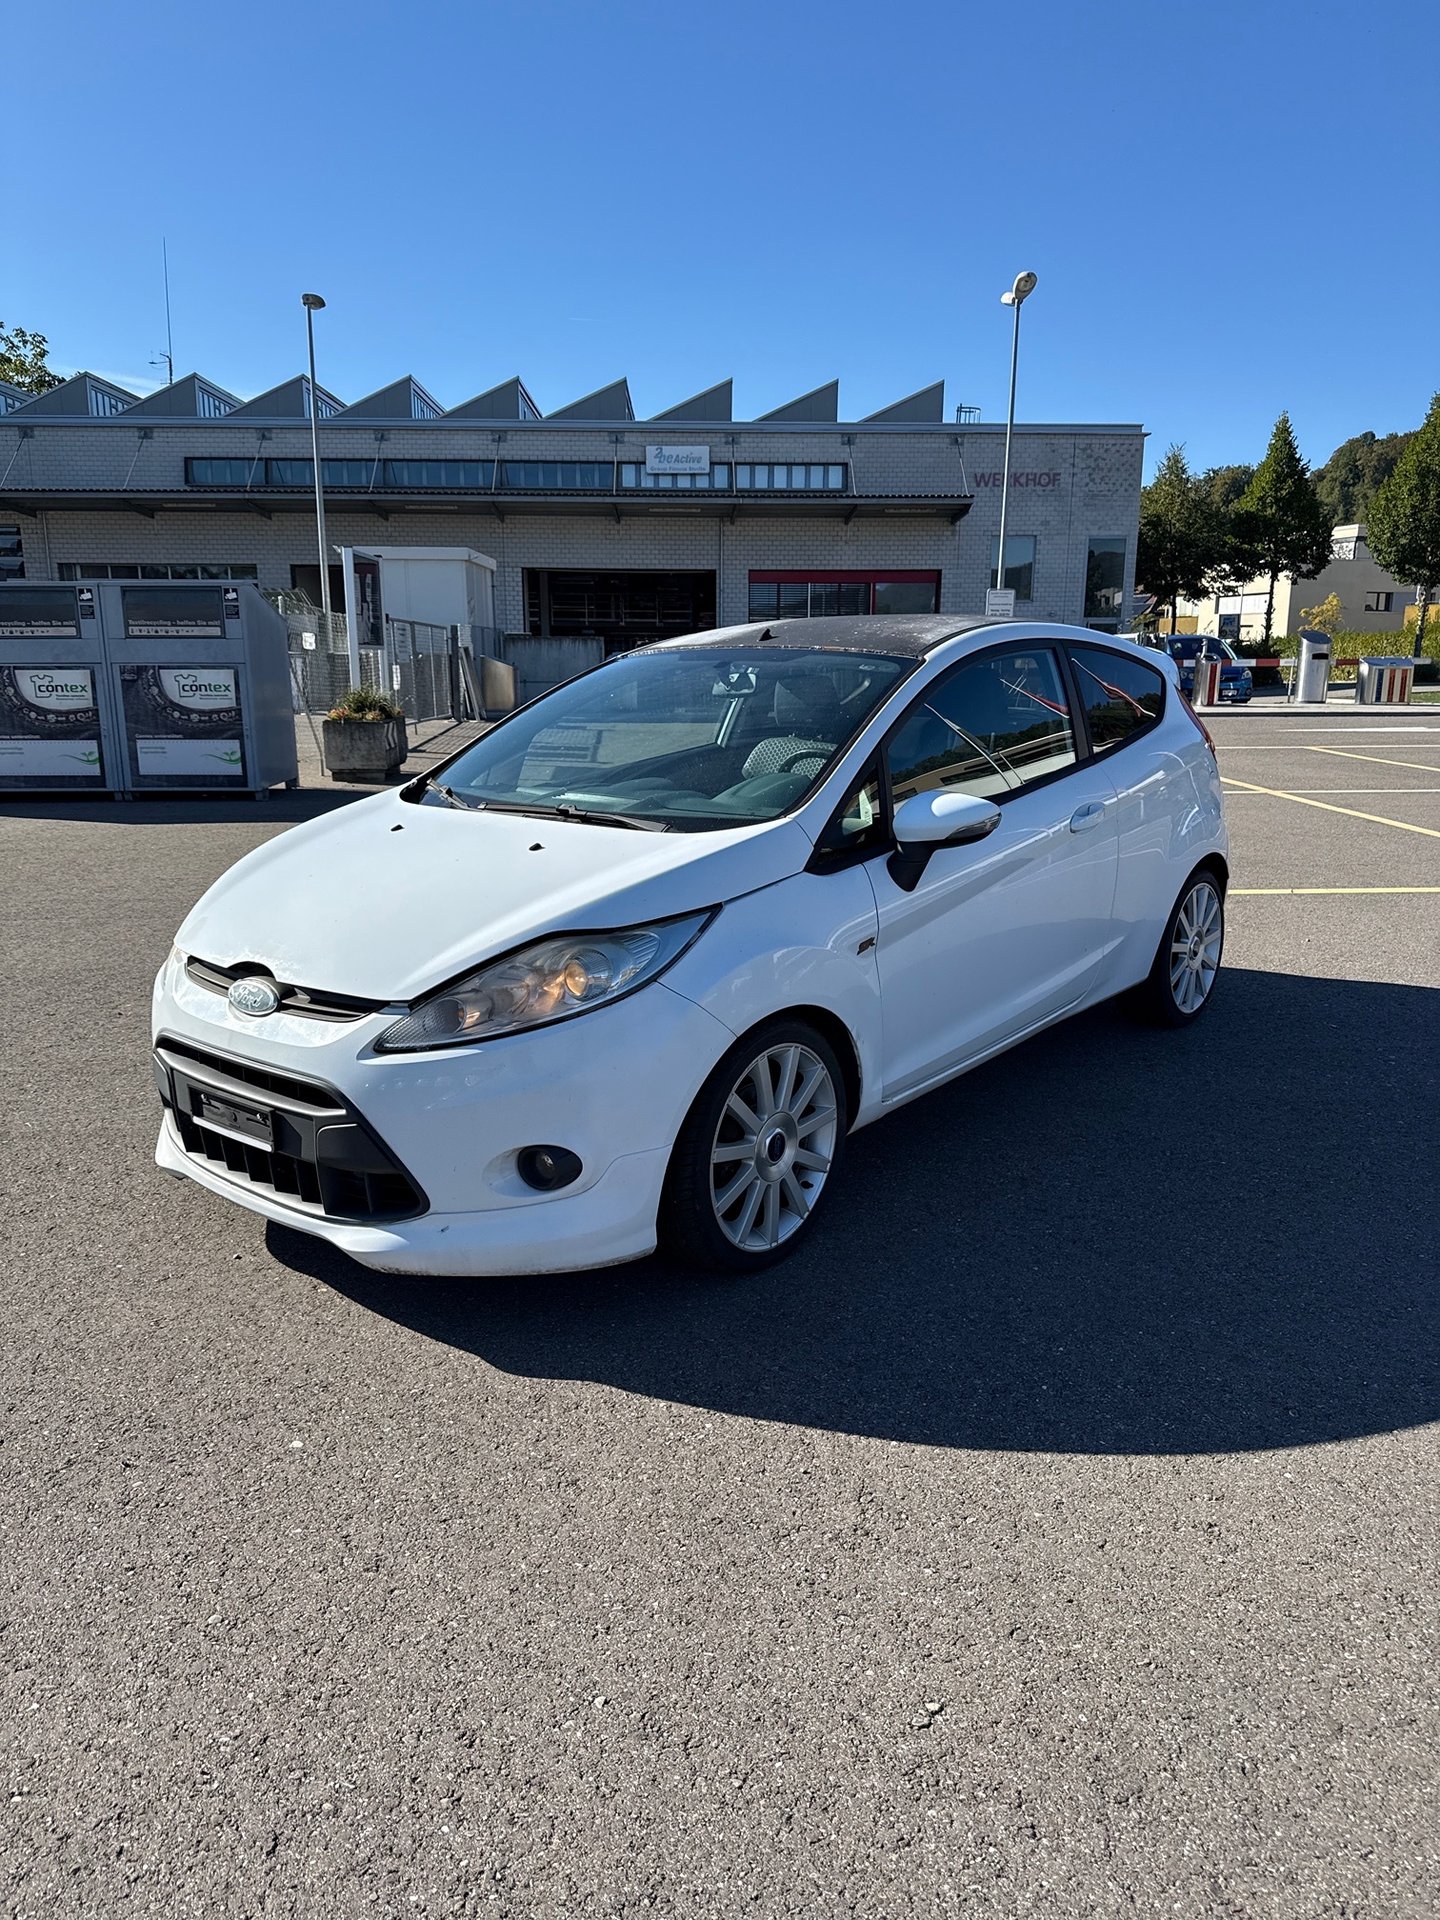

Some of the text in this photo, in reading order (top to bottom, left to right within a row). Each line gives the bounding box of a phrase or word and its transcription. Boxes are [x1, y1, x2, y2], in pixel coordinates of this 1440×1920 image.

[673, 452, 702, 464] Active
[38, 683, 88, 693] contex
[182, 683, 231, 693] contex
[235, 984, 264, 1010] Ford
